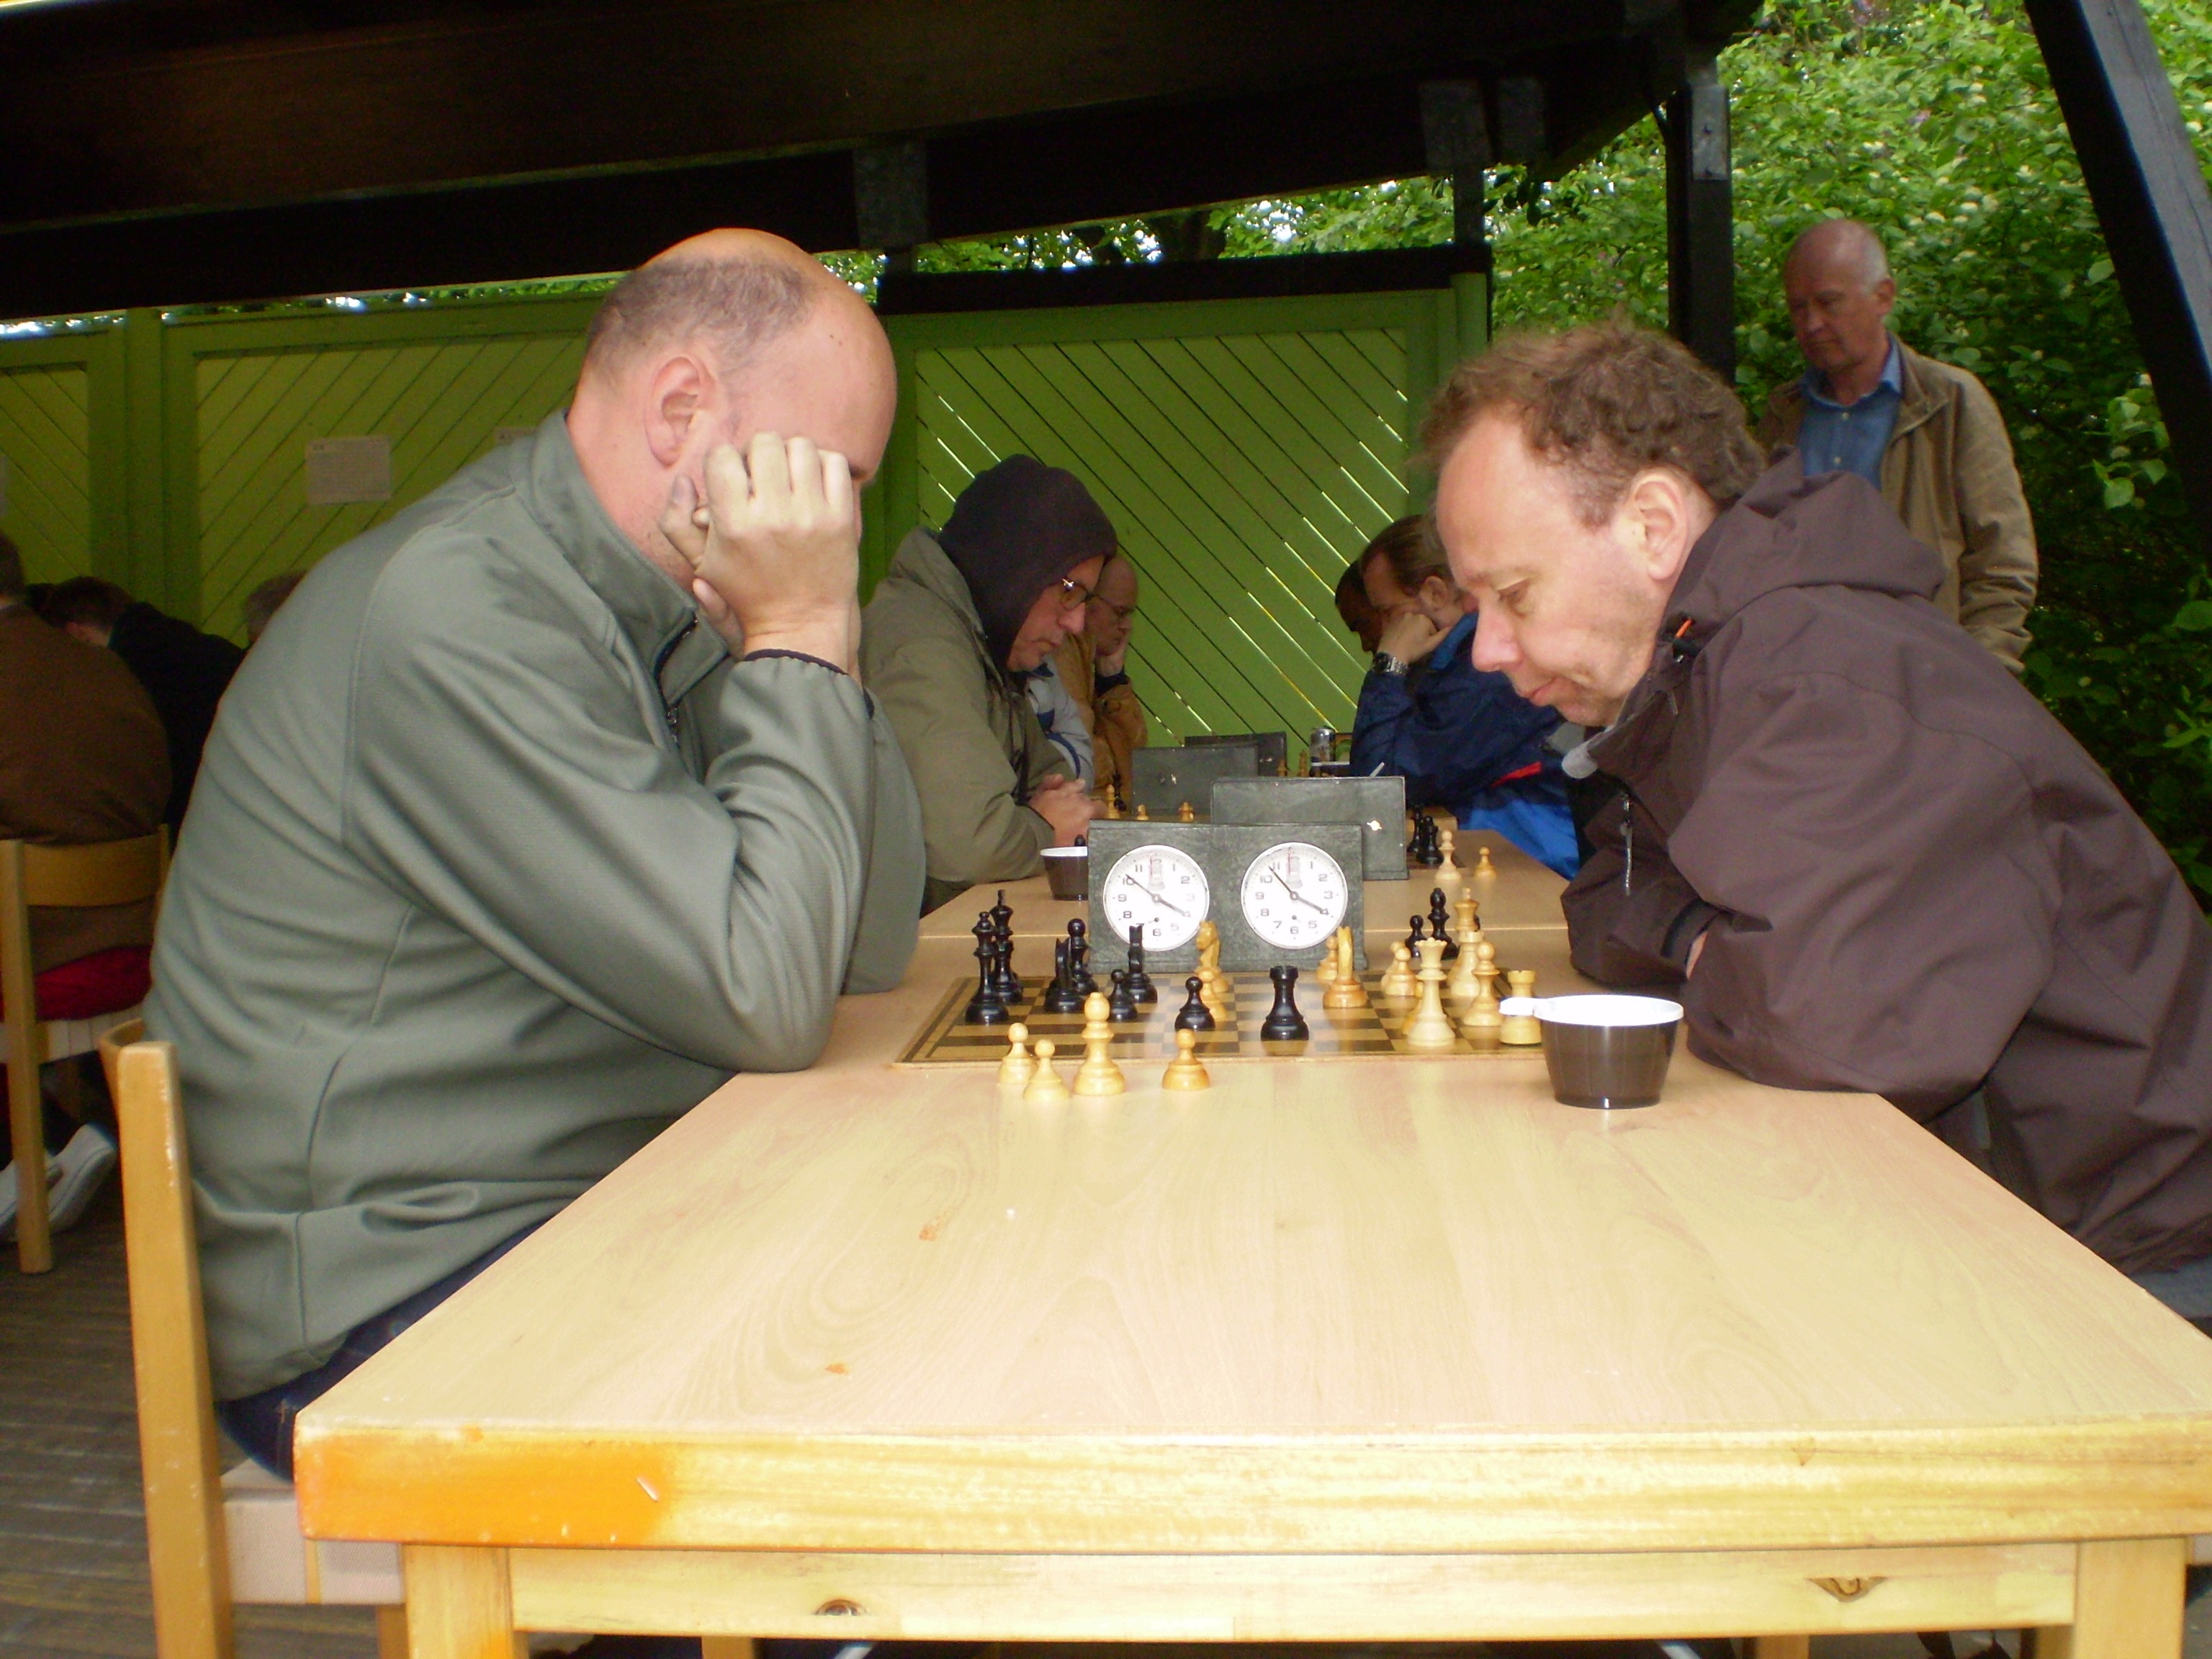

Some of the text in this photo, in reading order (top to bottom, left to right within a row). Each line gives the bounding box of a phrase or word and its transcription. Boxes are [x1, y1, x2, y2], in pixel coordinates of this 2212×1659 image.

[1135, 864, 1143, 873] 11
[1272, 861, 1280, 870] 11
[1123, 876, 1135, 886] 10
[1181, 876, 1190, 884] 2
[1260, 875, 1272, 884] 10
[1261, 908, 1269, 917] 8
[1273, 920, 1282, 929] 7
